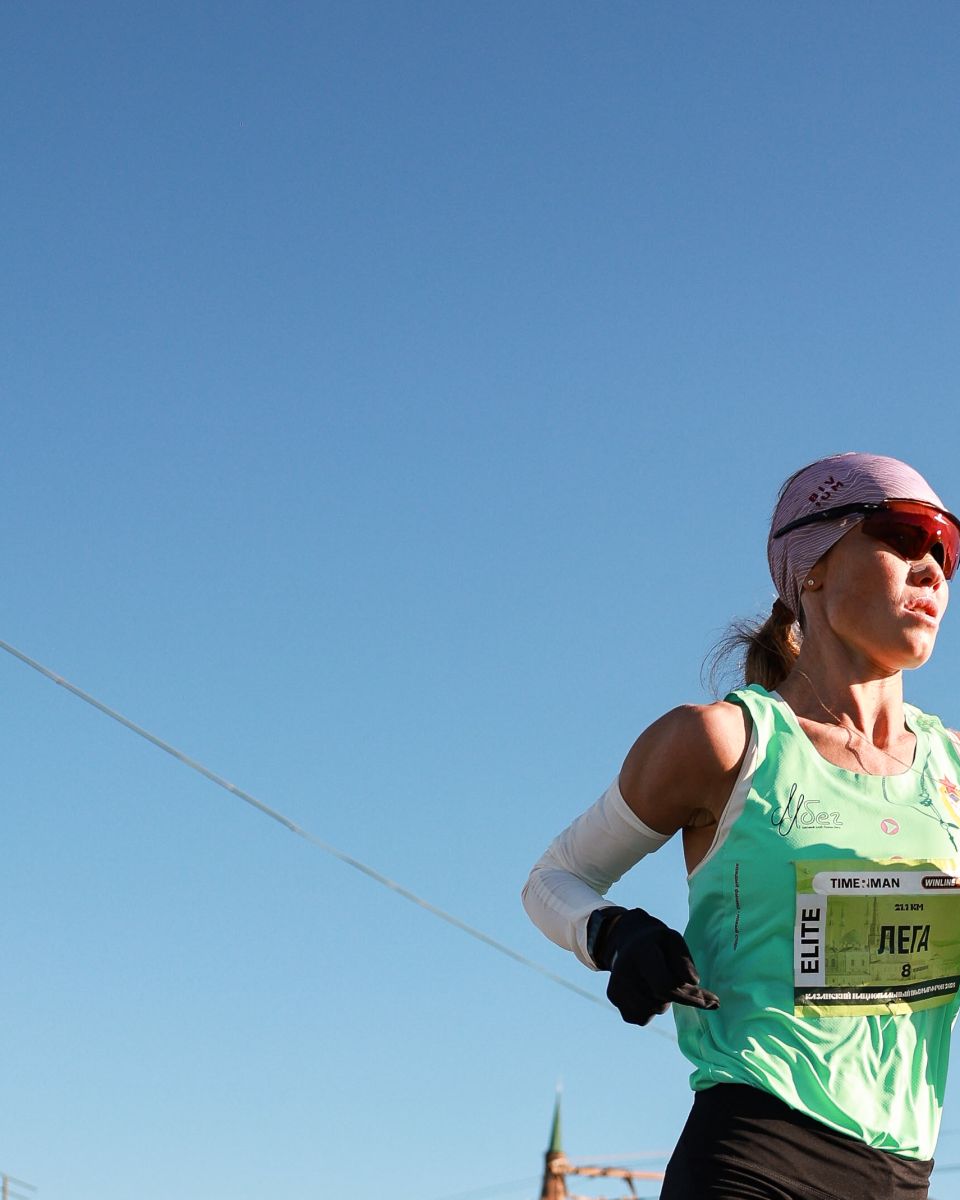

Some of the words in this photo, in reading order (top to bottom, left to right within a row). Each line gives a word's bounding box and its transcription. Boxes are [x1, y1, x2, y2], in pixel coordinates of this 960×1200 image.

[800, 907, 821, 974] ELITE
[877, 924, 931, 955] ЛЕГА
[901, 963, 912, 978] 8
